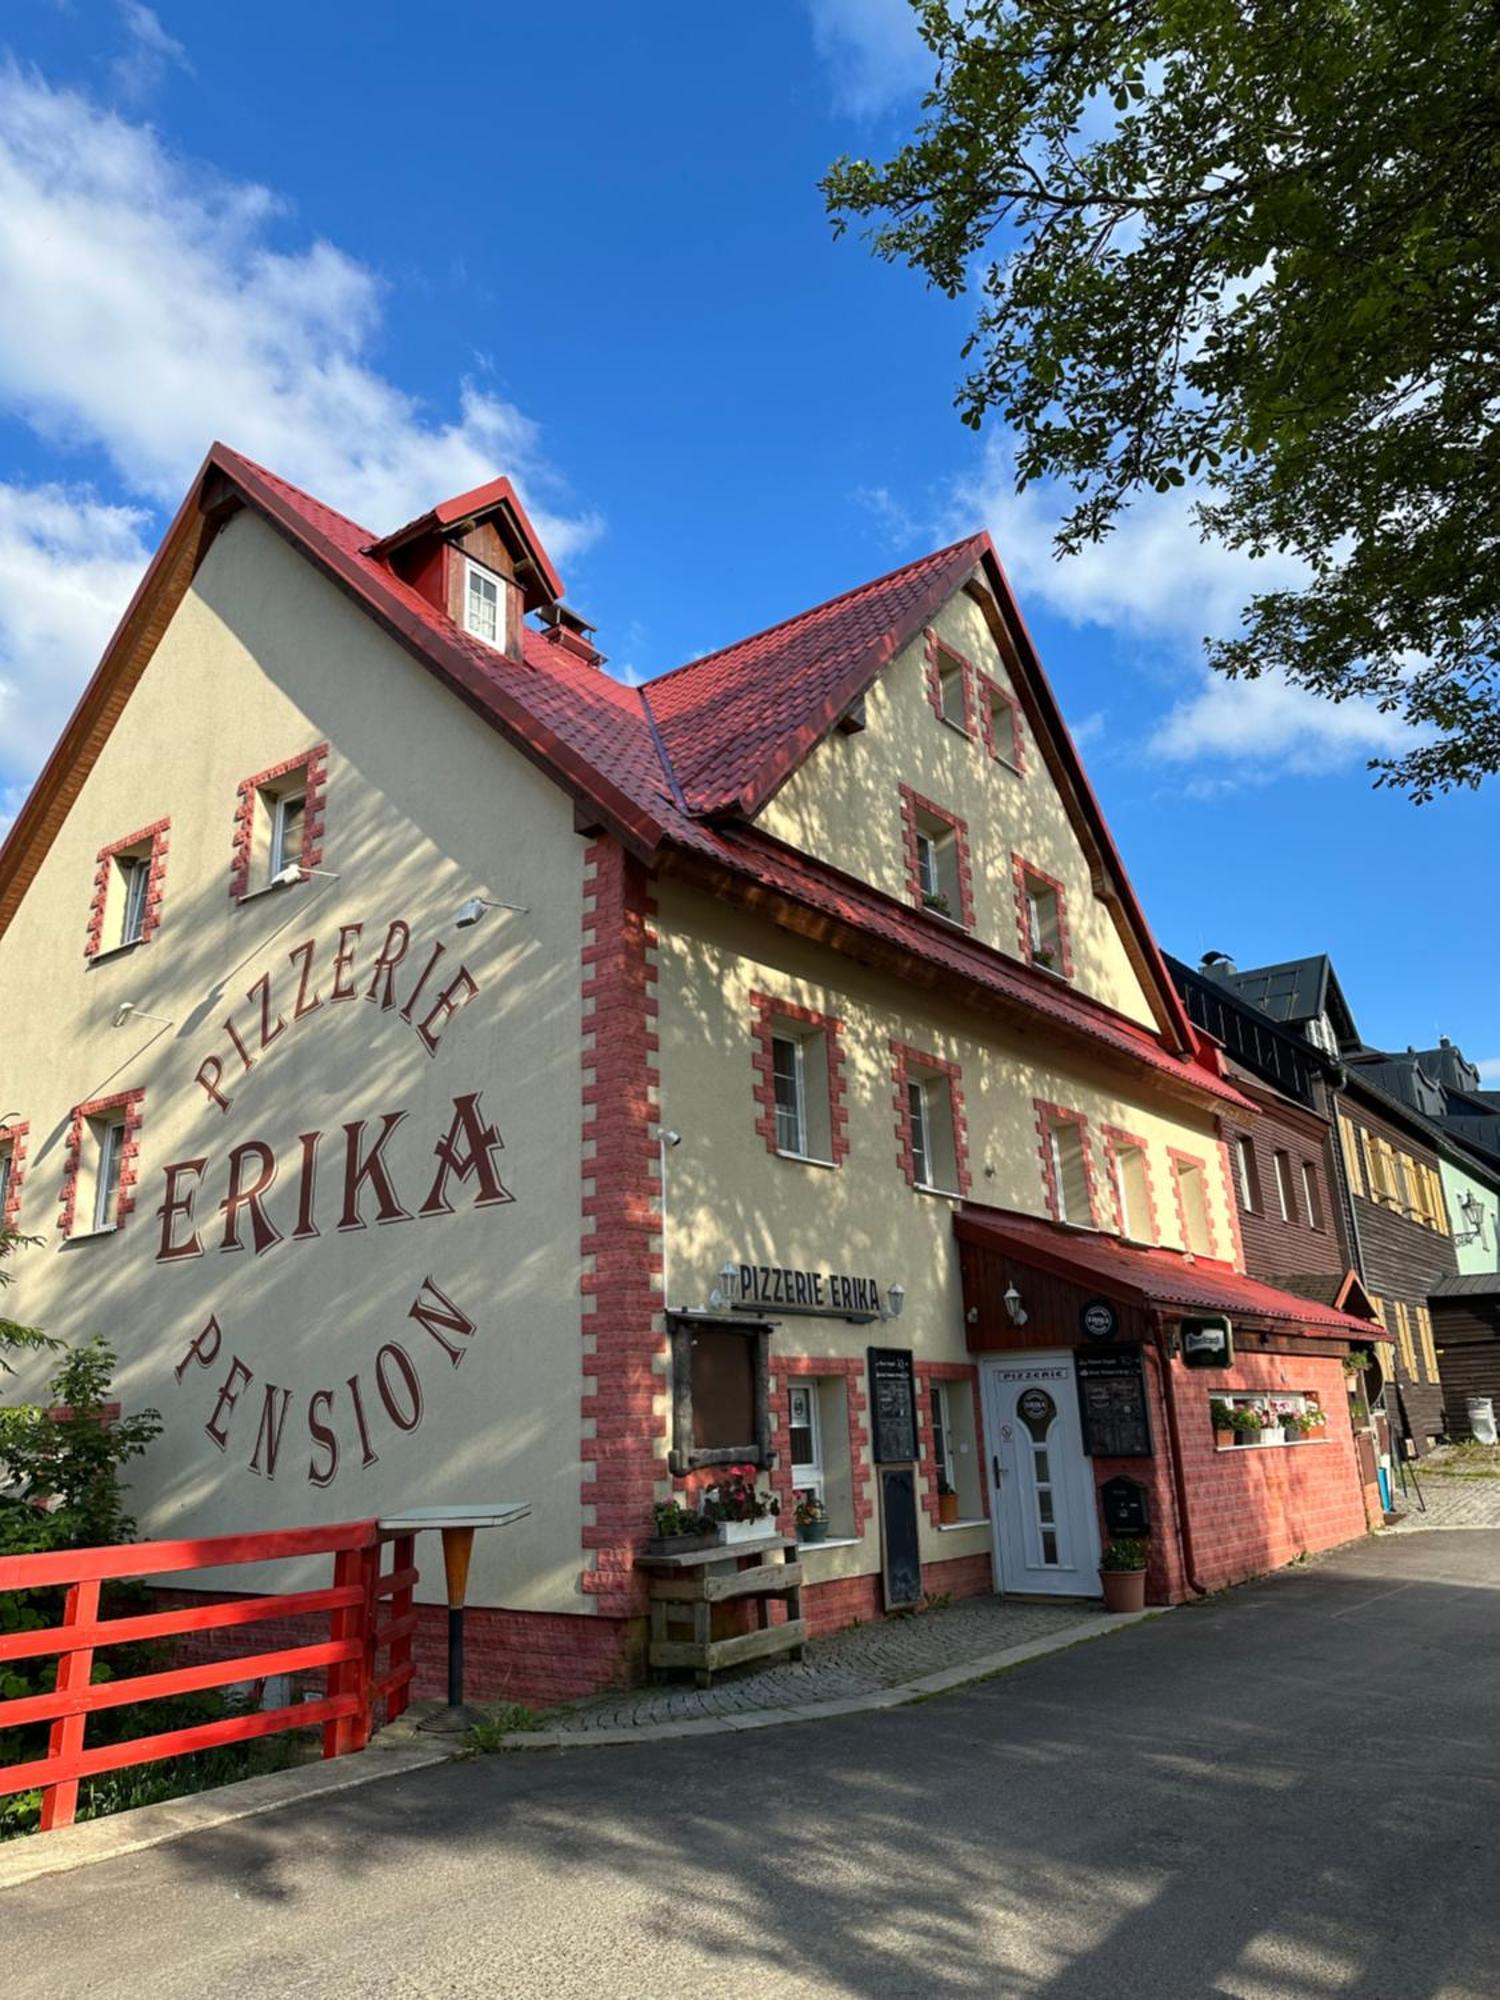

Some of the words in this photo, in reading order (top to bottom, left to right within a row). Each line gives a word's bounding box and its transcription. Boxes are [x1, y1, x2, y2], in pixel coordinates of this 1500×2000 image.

[195, 919, 479, 1113] PIZZERIE
[156, 1092, 516, 1263] ERIKA
[739, 1265, 824, 1305] PIZZERIE
[829, 1275, 880, 1310] ERIKA
[174, 1274, 477, 1488] PENSION
